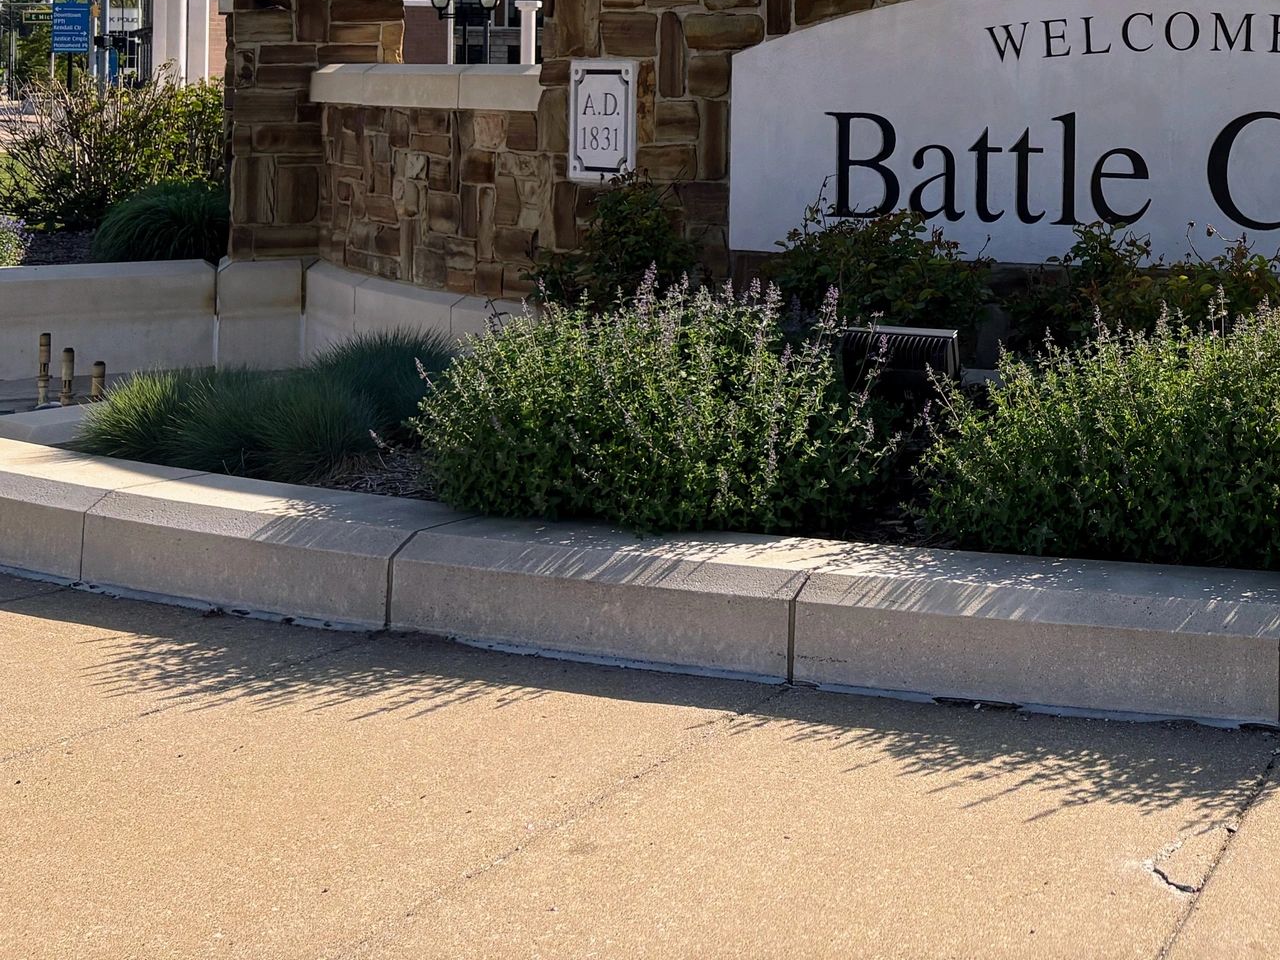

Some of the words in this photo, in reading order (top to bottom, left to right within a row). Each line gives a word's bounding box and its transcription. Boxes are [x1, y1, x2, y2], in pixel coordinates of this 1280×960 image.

[582, 92, 620, 116] A.D.
[581, 126, 618, 151] 1831
[824, 111, 1152, 226] Battle
